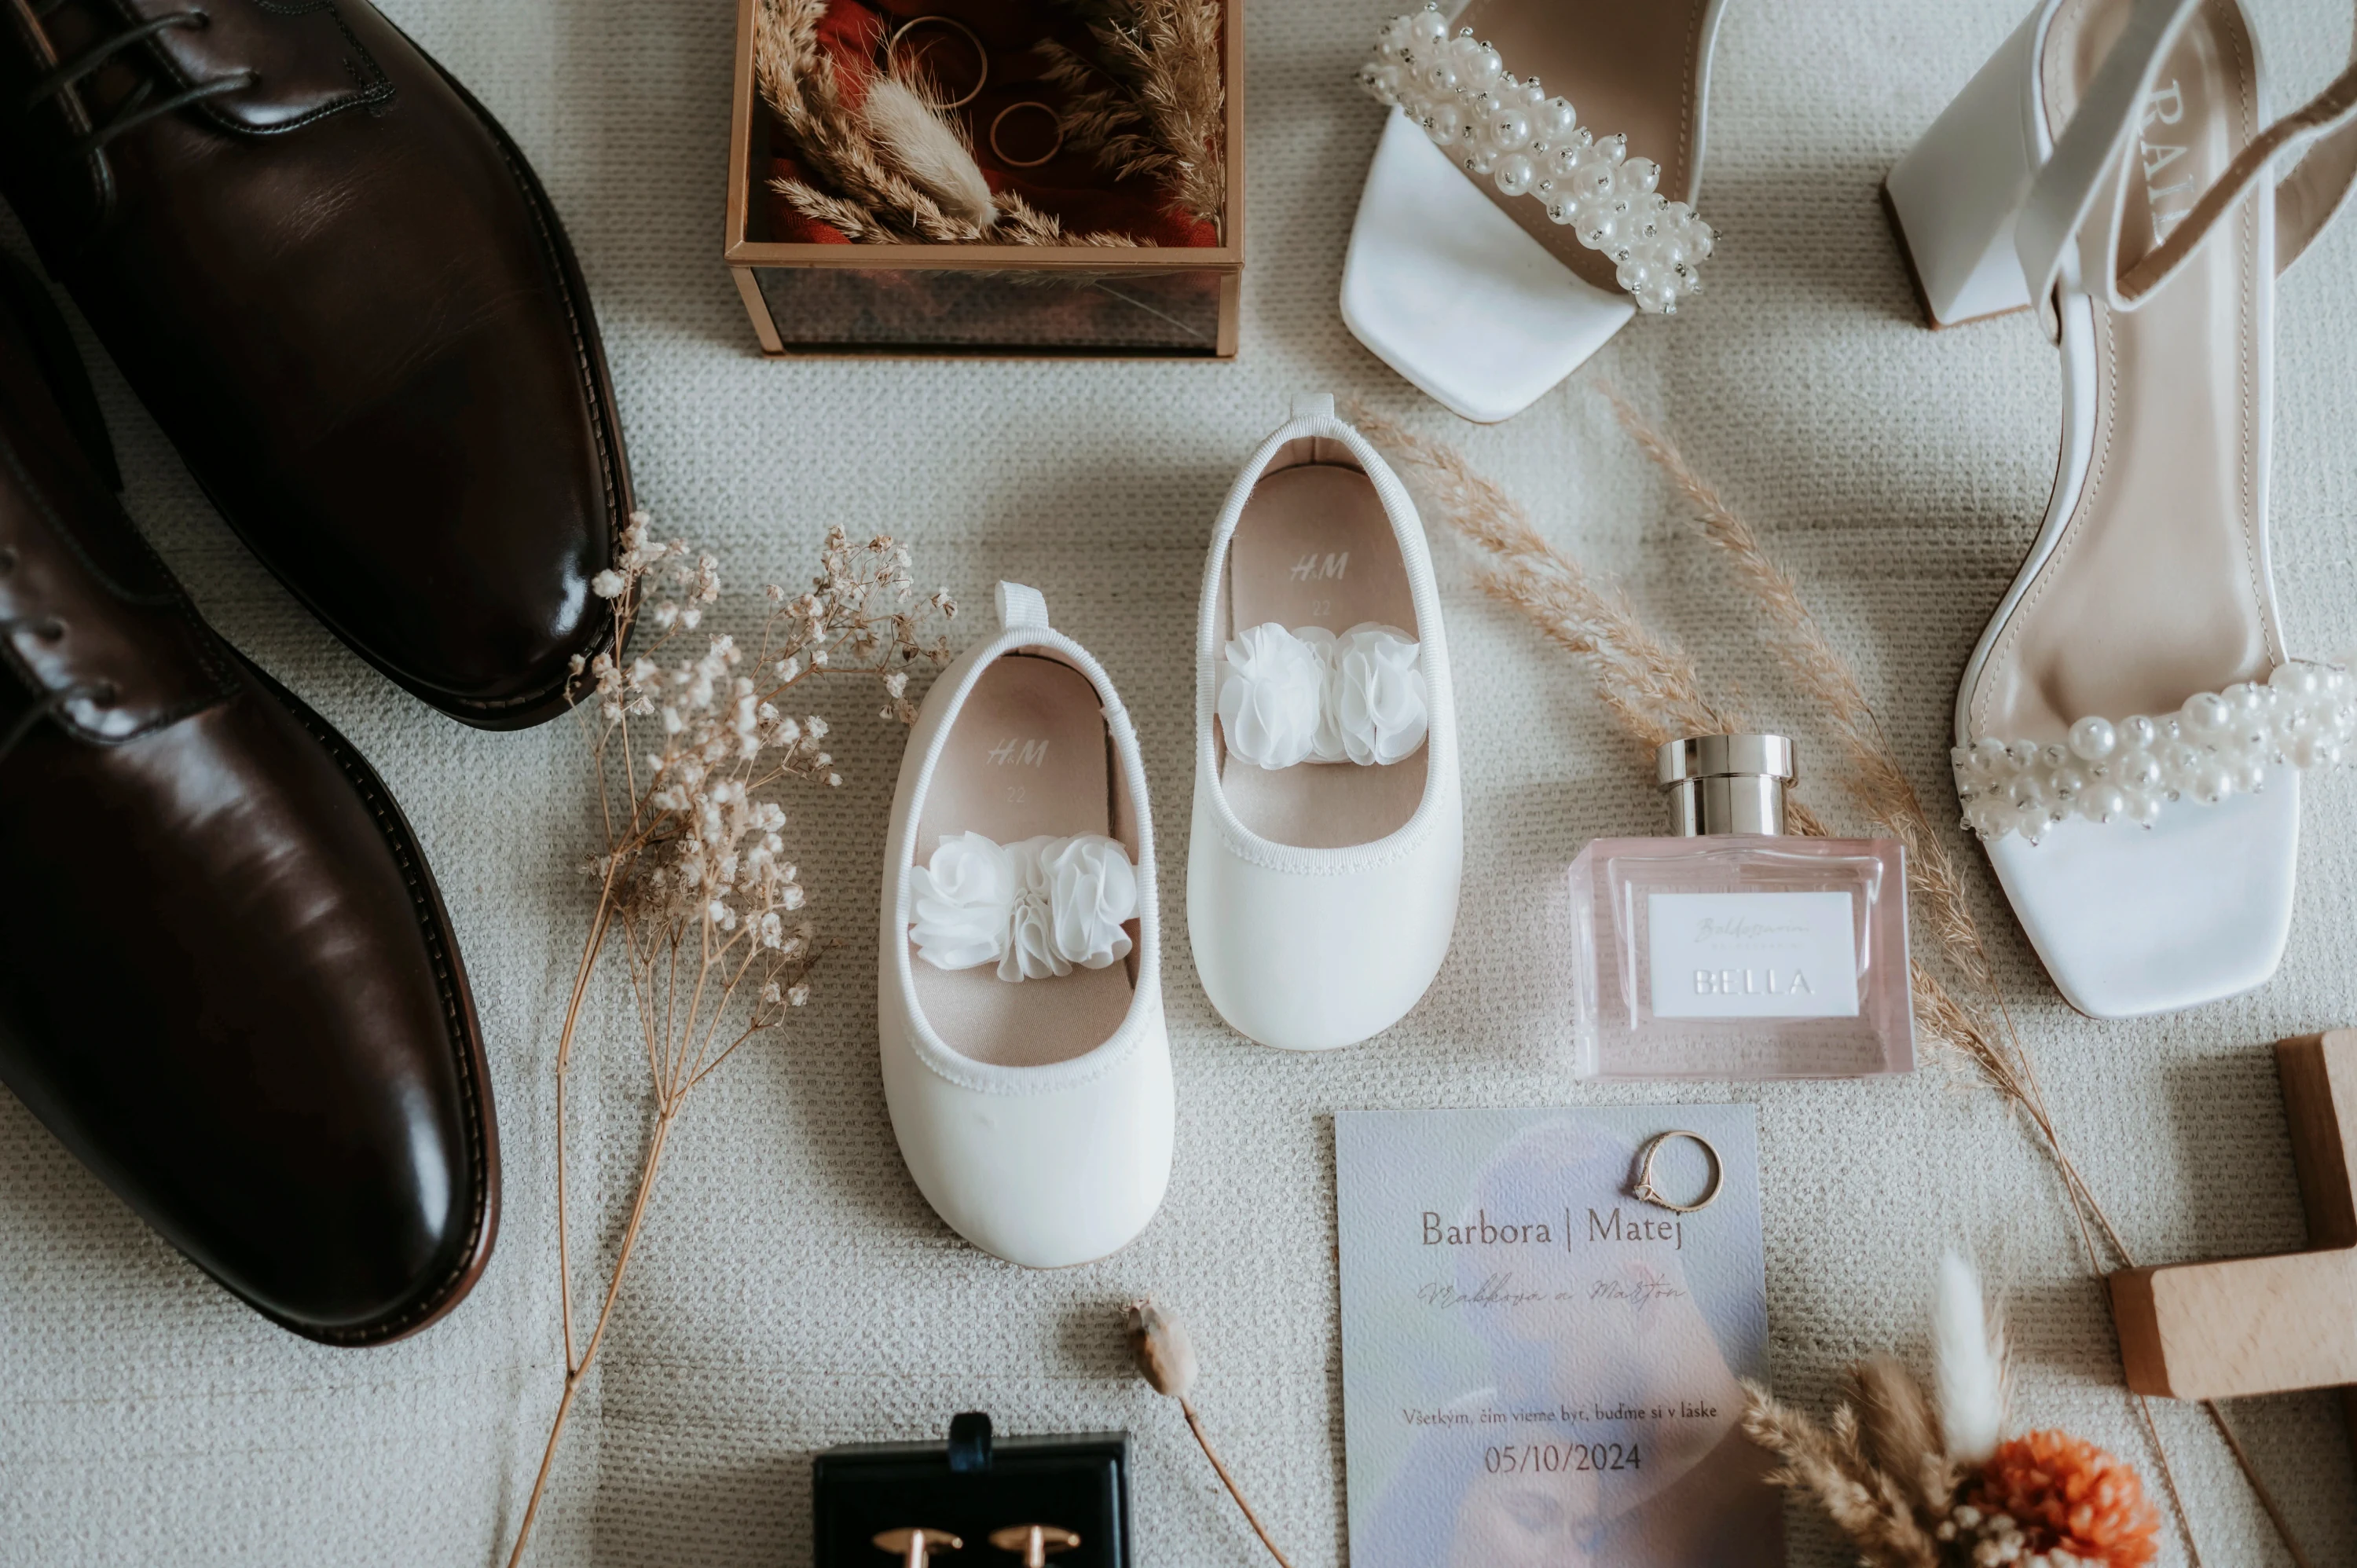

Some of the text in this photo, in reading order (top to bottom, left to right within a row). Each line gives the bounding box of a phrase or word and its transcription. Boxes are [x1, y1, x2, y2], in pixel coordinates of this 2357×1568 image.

[1290, 551, 1350, 581] H&M
[1313, 599, 1331, 616] 22
[986, 738, 1050, 768] H&M
[1006, 786, 1026, 803] 22
[1693, 968, 1816, 996] BELLA
[1421, 1208, 1552, 1247] Barbora
[1587, 1207, 1684, 1251] Matej
[1402, 1407, 1474, 1429] Všetkým,
[1479, 1407, 1507, 1424] čím
[1512, 1408, 1556, 1423] vieme
[1595, 1402, 1645, 1421] buďme
[1651, 1404, 1662, 1419] si
[1667, 1409, 1676, 1418] v
[1681, 1401, 1717, 1418] láske
[1485, 1442, 1641, 1474] 05/10/2024
